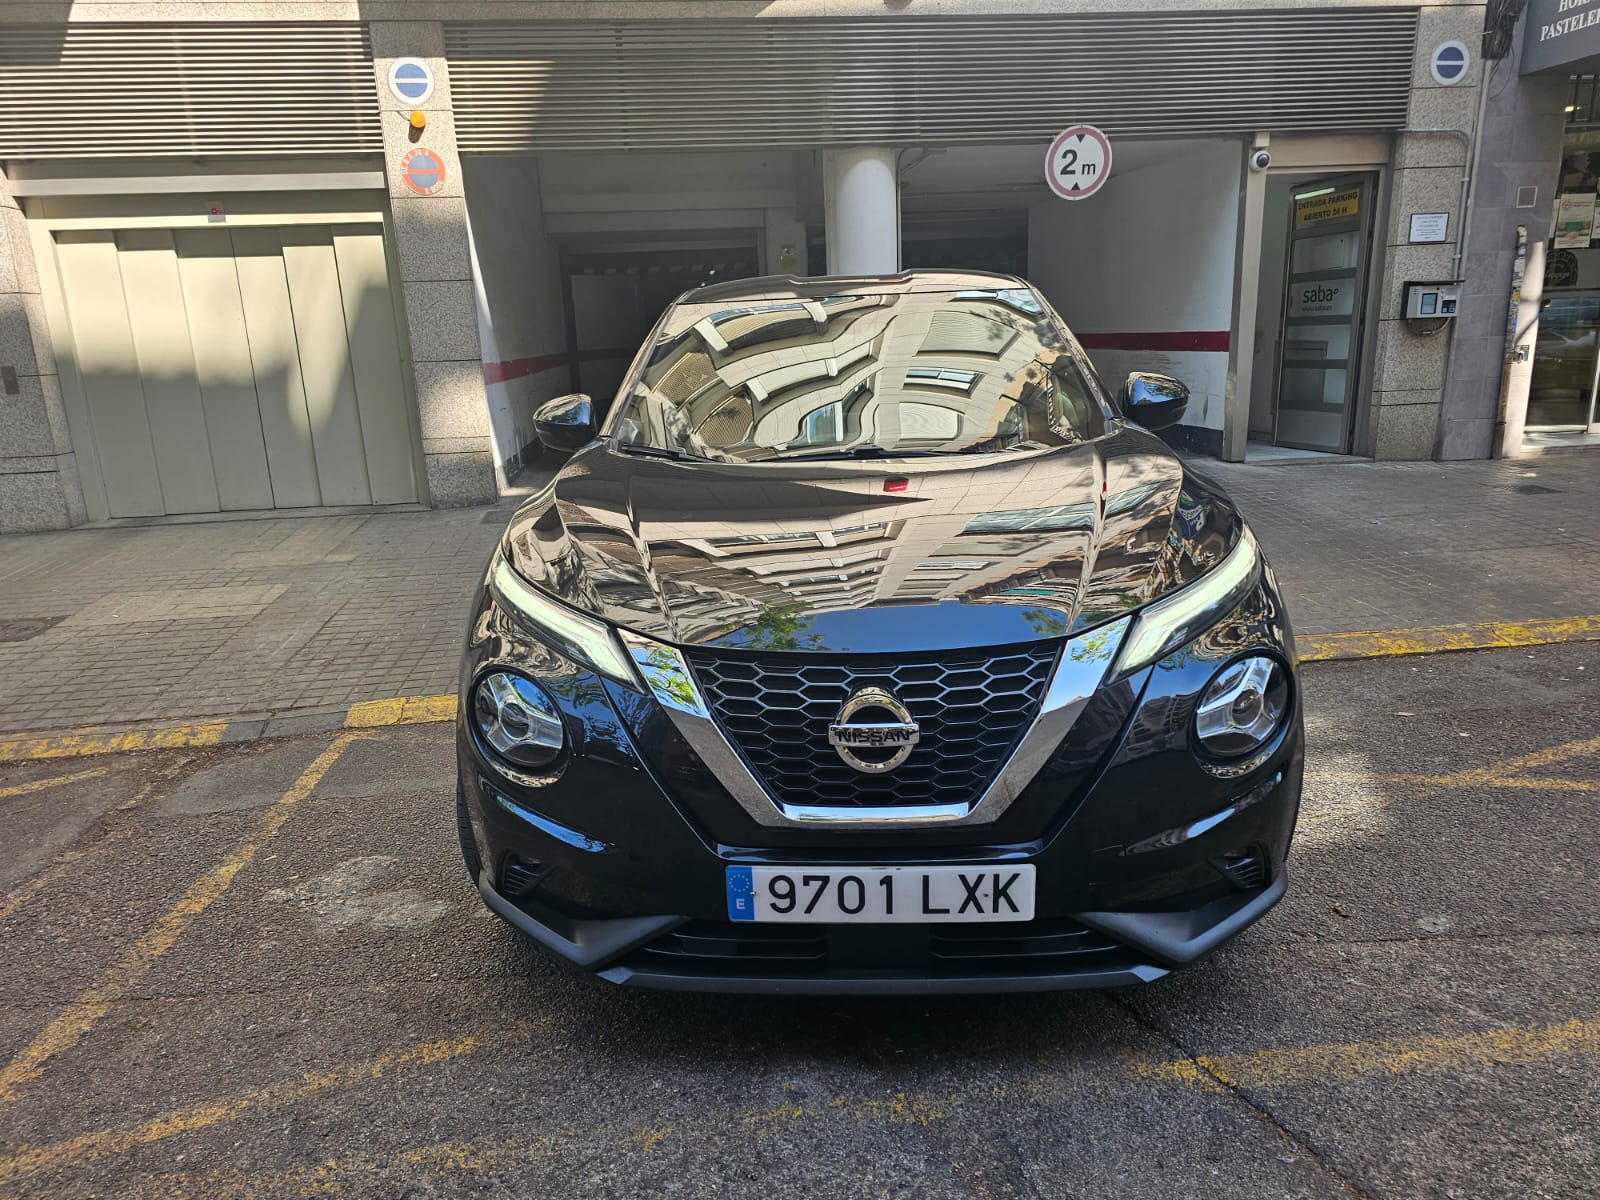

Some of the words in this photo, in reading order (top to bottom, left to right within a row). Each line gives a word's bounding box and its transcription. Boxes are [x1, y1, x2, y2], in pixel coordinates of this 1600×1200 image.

[1060, 149, 1078, 176] 2
[1081, 163, 1096, 176] m
[1297, 198, 1327, 210] ENTRADA
[1328, 191, 1358, 205] PARKING
[1303, 209, 1331, 221] ABIERTO
[1332, 207, 1340, 217] 24
[1303, 284, 1333, 304] saba
[834, 728, 912, 743] NISSAN
[768, 874, 894, 915] 9701
[921, 873, 1021, 915] LXK
[735, 898, 746, 910] E
